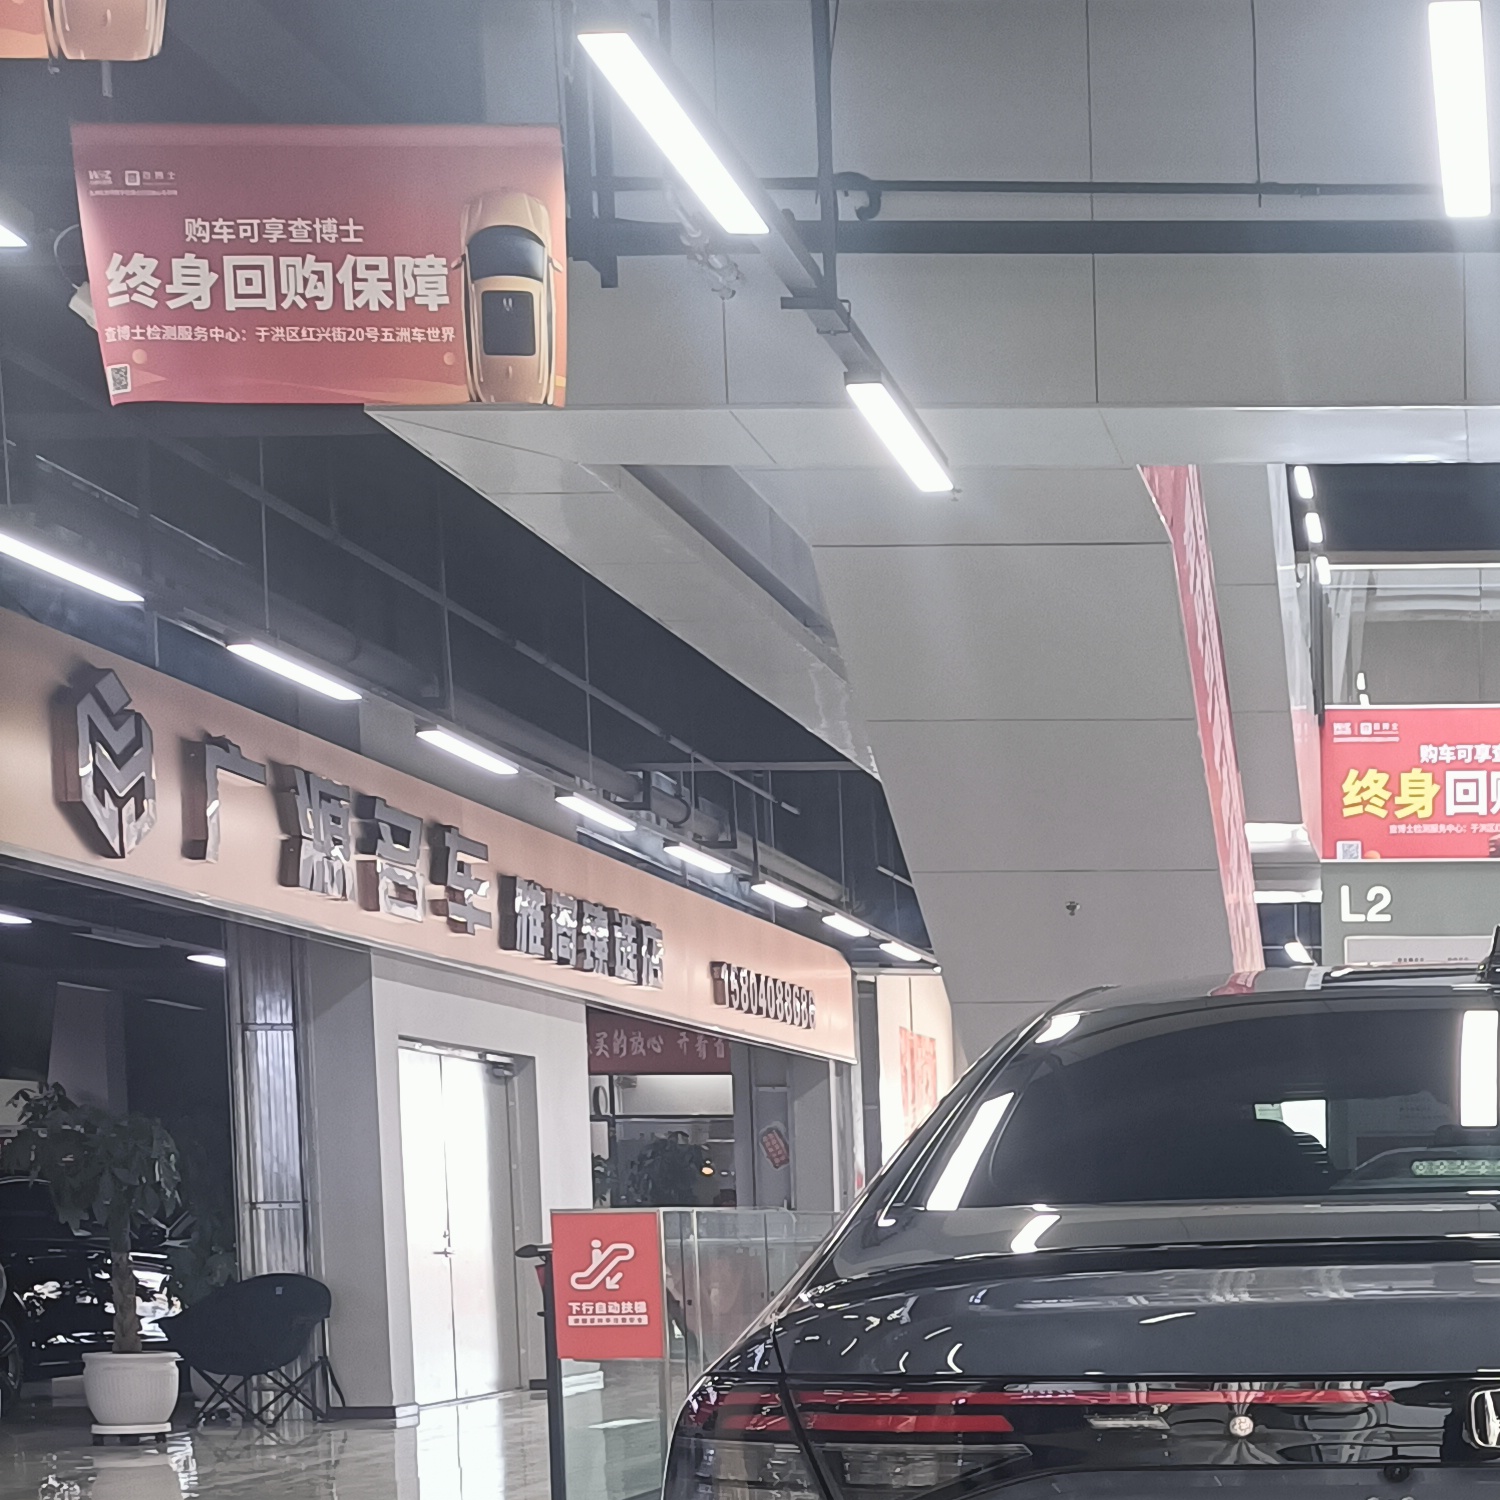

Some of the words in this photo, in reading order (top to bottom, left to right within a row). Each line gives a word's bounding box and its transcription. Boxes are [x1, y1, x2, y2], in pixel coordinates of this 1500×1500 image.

[184, 217, 364, 245] 购车可享查博士
[104, 252, 451, 313] 终身回购保障
[1339, 885, 1393, 923] L2
